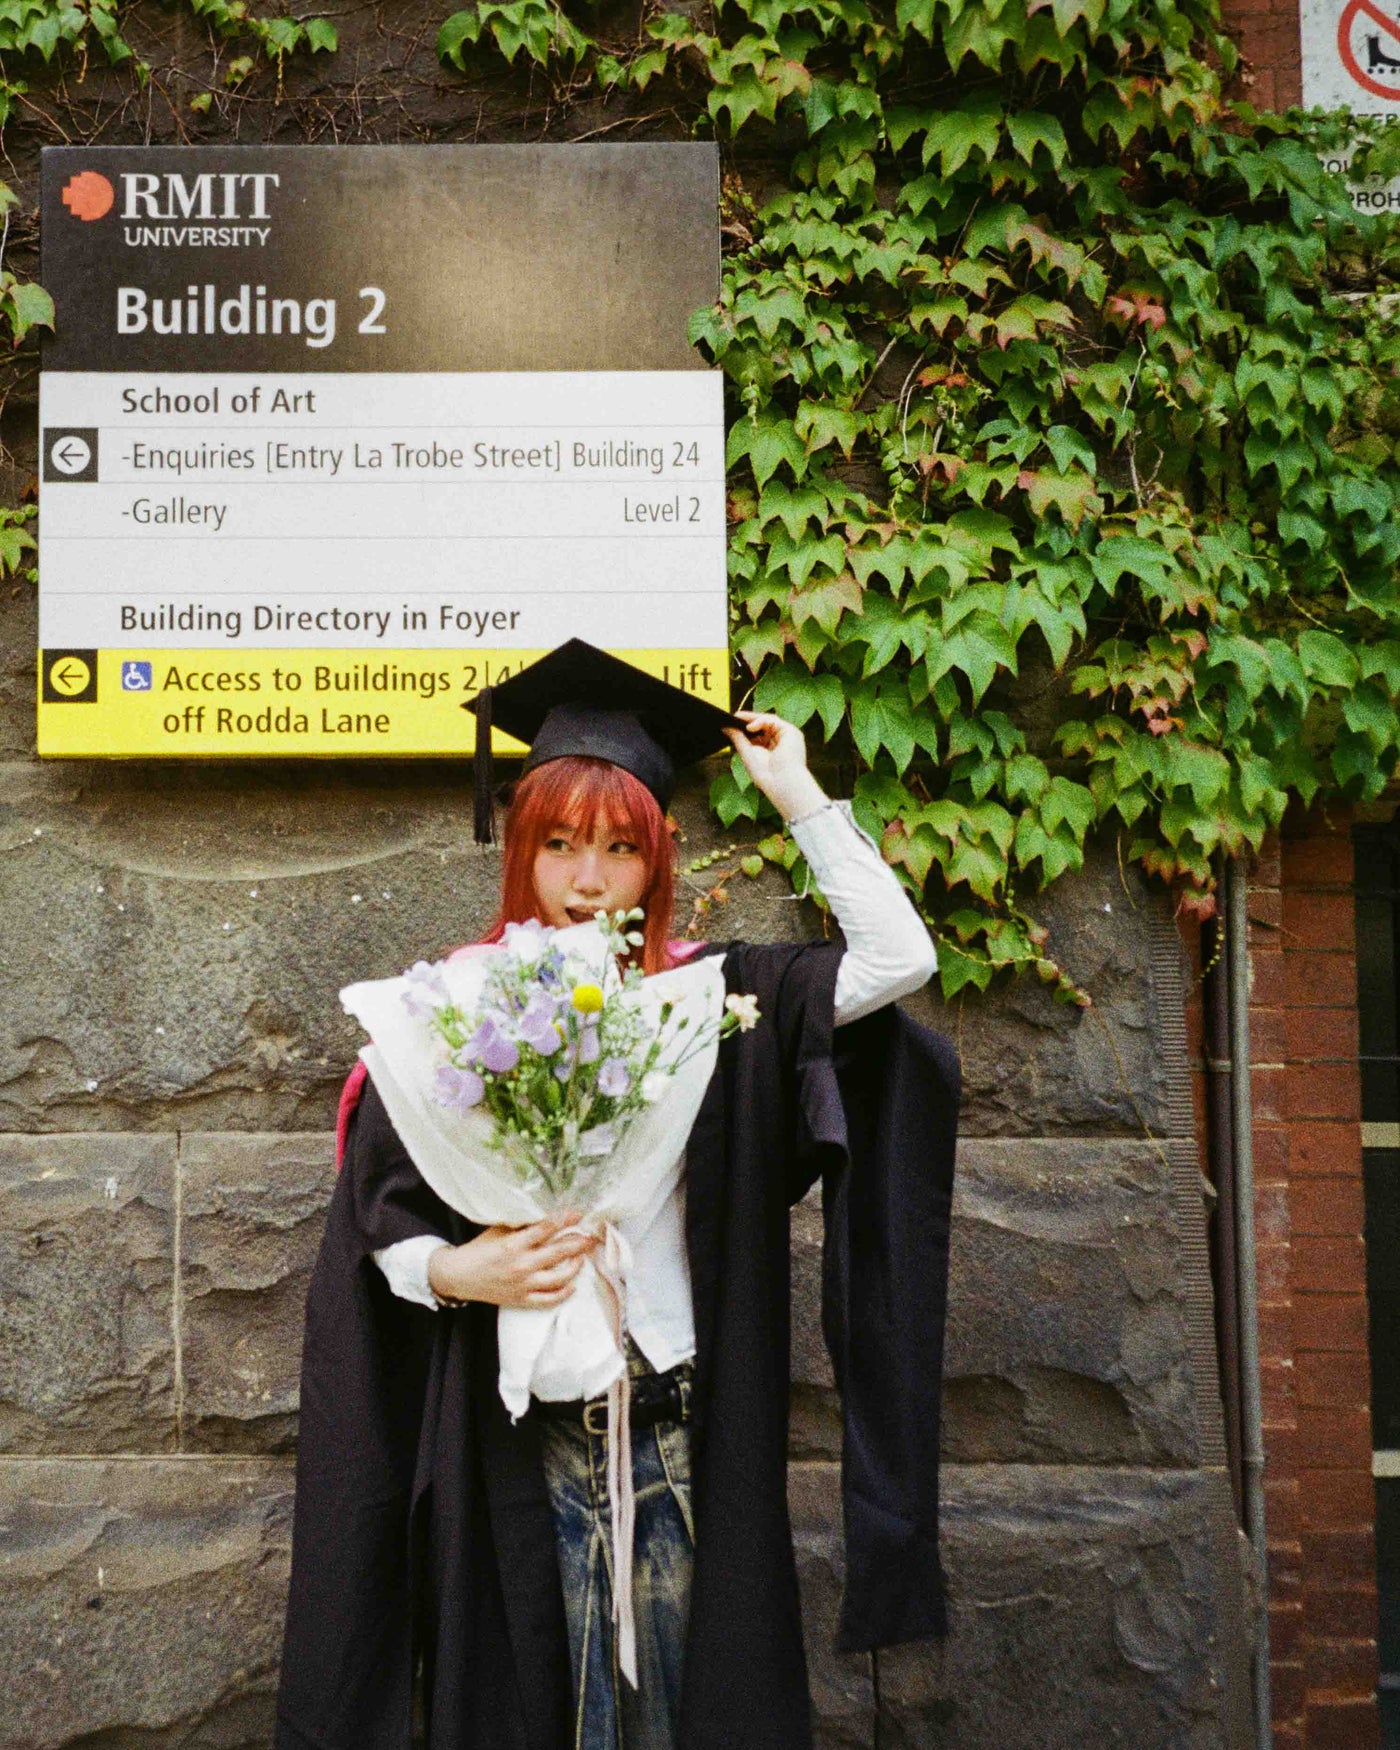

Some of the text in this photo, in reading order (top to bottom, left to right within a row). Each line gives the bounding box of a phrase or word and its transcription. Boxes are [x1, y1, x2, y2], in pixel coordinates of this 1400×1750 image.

[120, 173, 280, 219] RMIT
[123, 226, 272, 247] UNIVERSITY
[117, 284, 388, 349] Building 2
[122, 386, 316, 414] School of Art
[121, 440, 700, 476] -Enquiries [Entry La Trobe Street] Building 24
[121, 495, 701, 532] -Gallery Level 2
[121, 604, 521, 638] Building Directory in Foyer
[163, 666, 261, 691] Access
[273, 668, 302, 691] to
[315, 664, 451, 699] Buildings
[163, 706, 391, 733] off Rodda Lane
